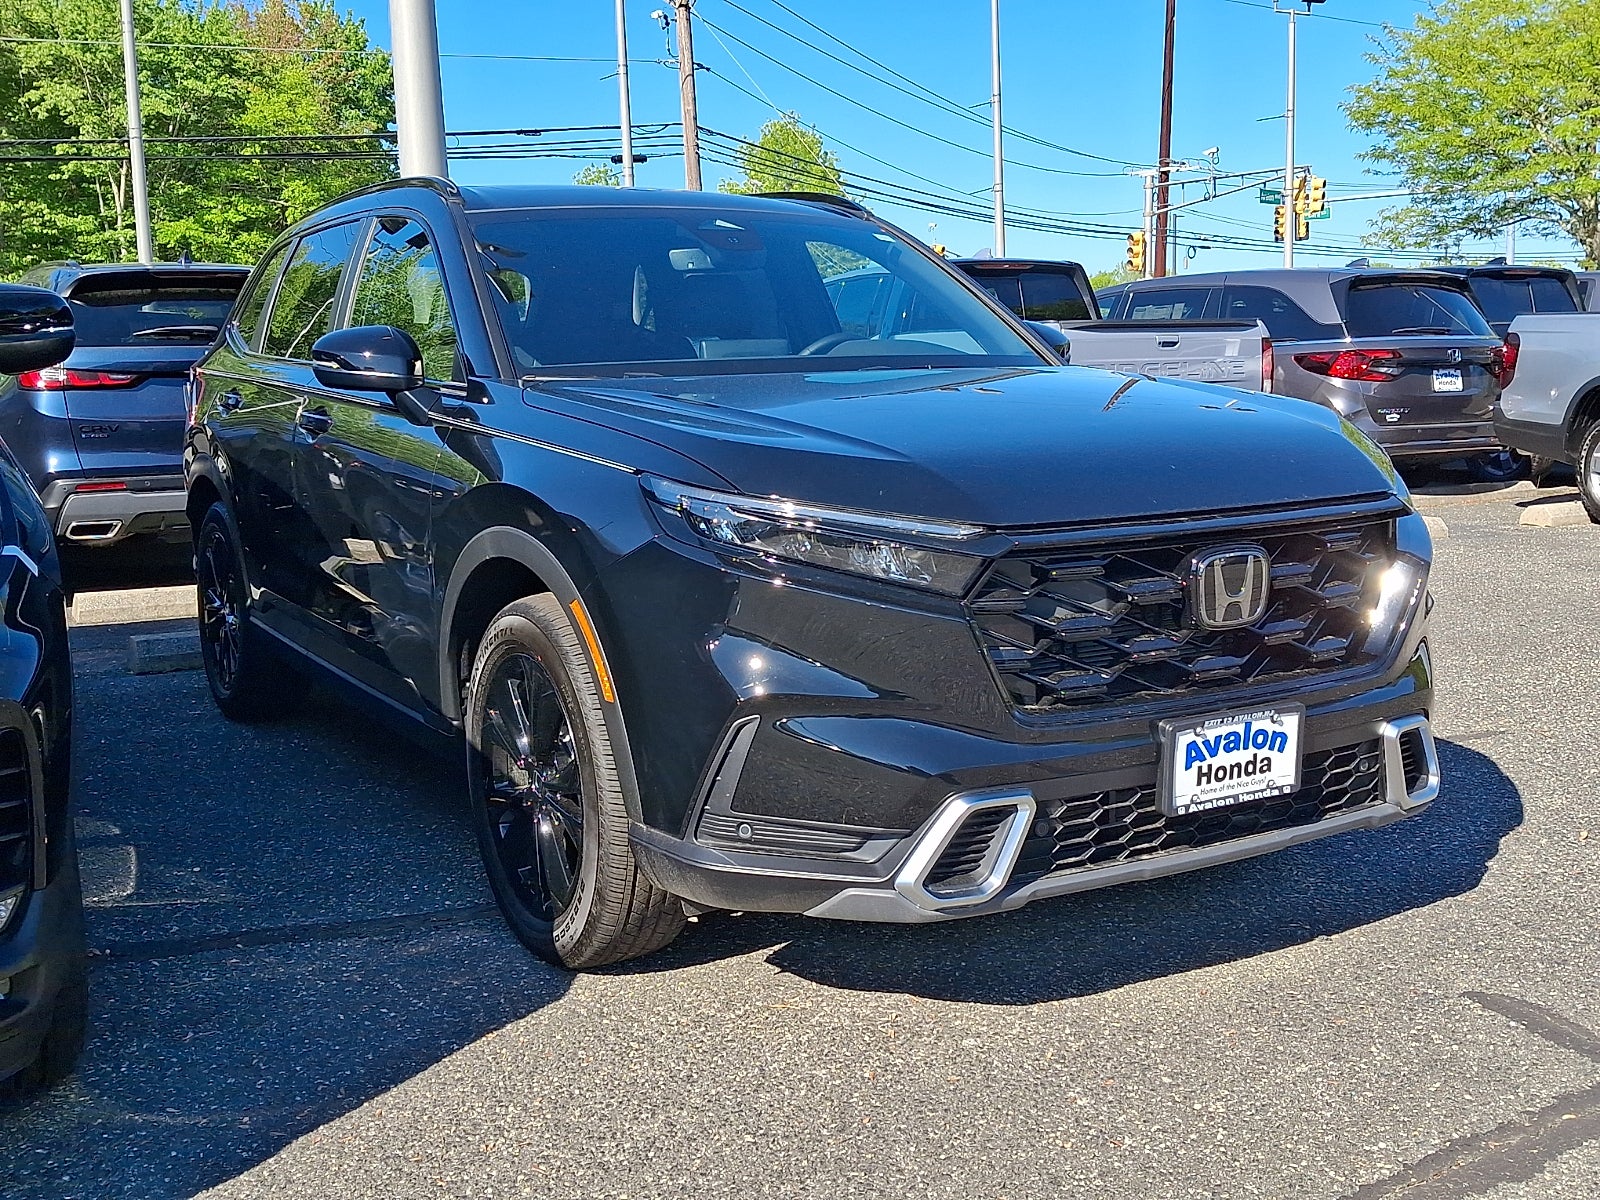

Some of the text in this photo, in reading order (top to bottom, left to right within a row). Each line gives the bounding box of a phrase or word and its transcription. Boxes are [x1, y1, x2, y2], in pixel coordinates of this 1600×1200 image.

[1204, 718, 1223, 728] EXIT
[1184, 721, 1288, 771] Avalon
[1196, 753, 1272, 786] Honda
[1188, 788, 1280, 813] Avalon Honda
[1200, 786, 1217, 796] Home
[1218, 784, 1226, 792] of
[1226, 782, 1236, 791] the
[1236, 780, 1250, 789] Nice
